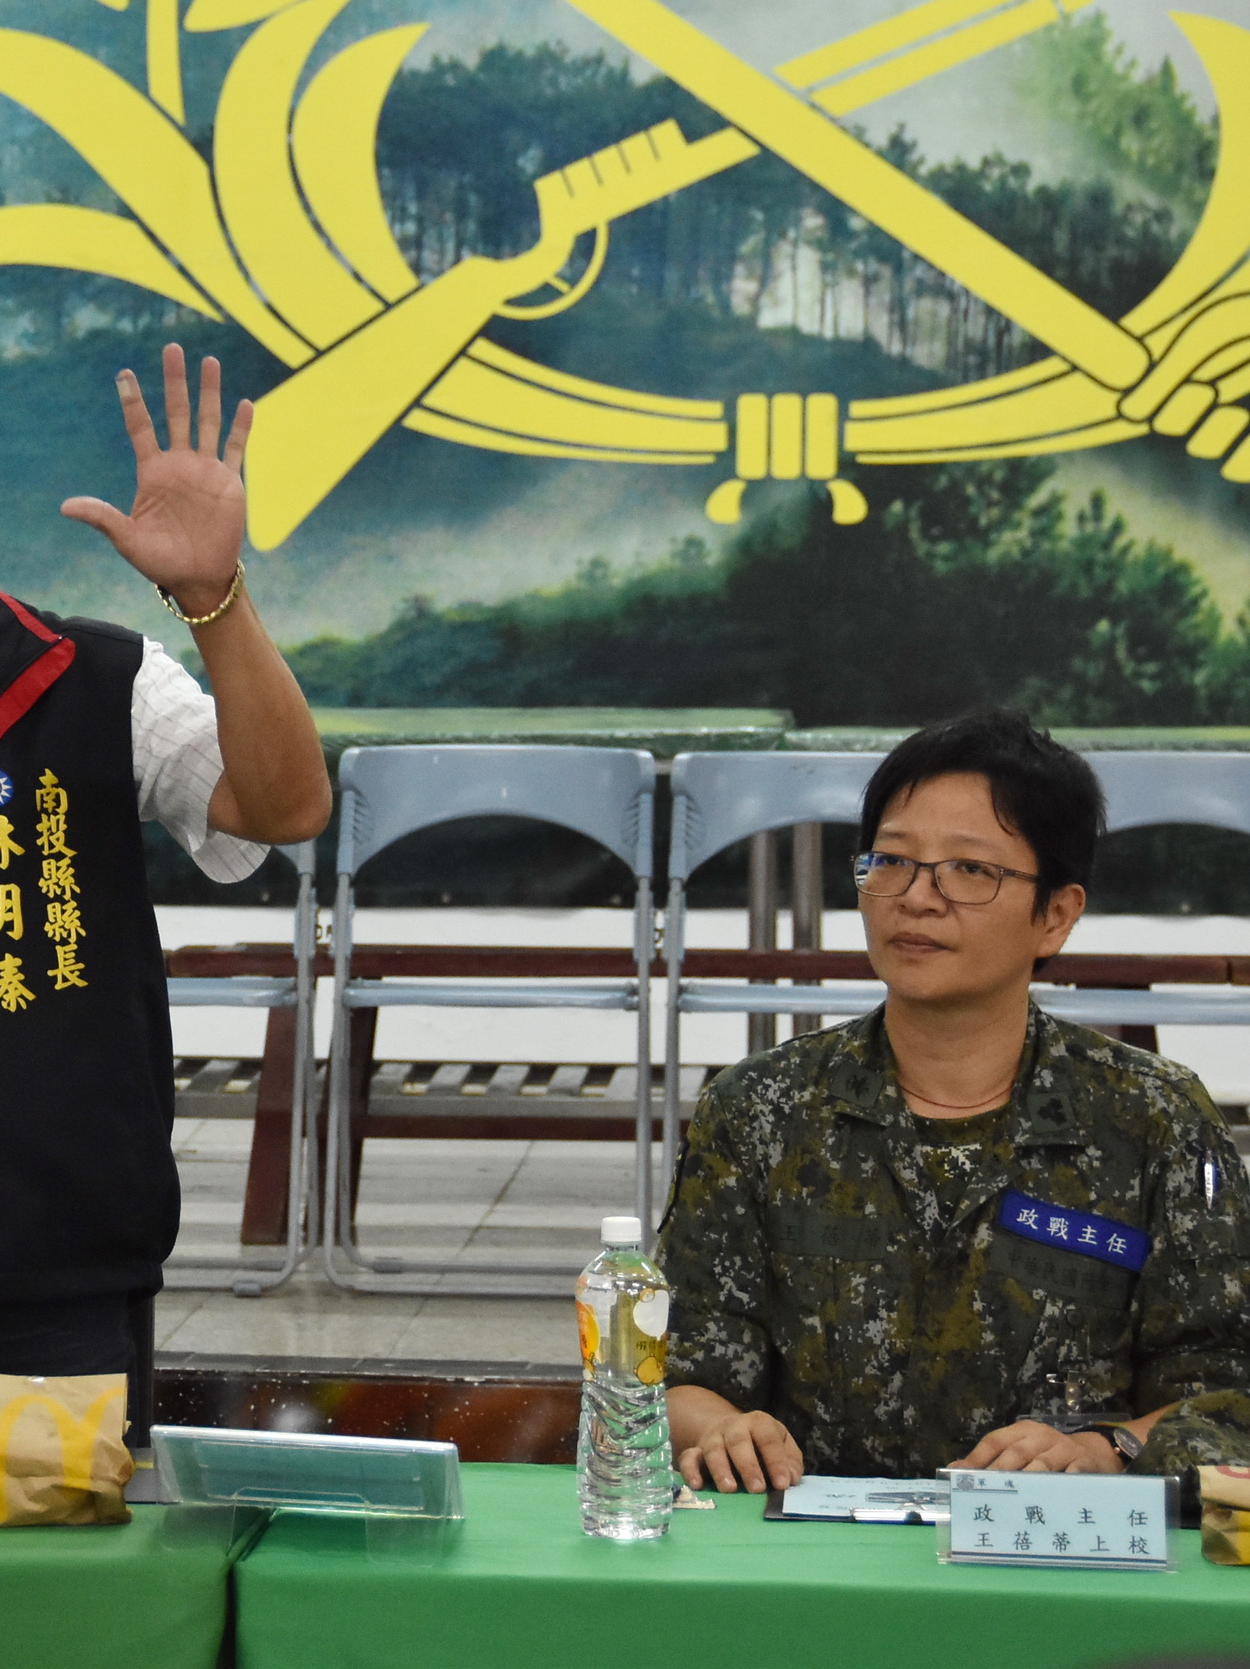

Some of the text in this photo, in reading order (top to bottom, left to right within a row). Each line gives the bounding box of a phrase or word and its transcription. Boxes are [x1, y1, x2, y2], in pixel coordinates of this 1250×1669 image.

[35, 768, 88, 990] 南投縣縣長
[1016, 1208, 1127, 1255] 政戰主任
[973, 1504, 1149, 1527] 政戰主任
[974, 1531, 1150, 1555] 王蓓蒂上校
